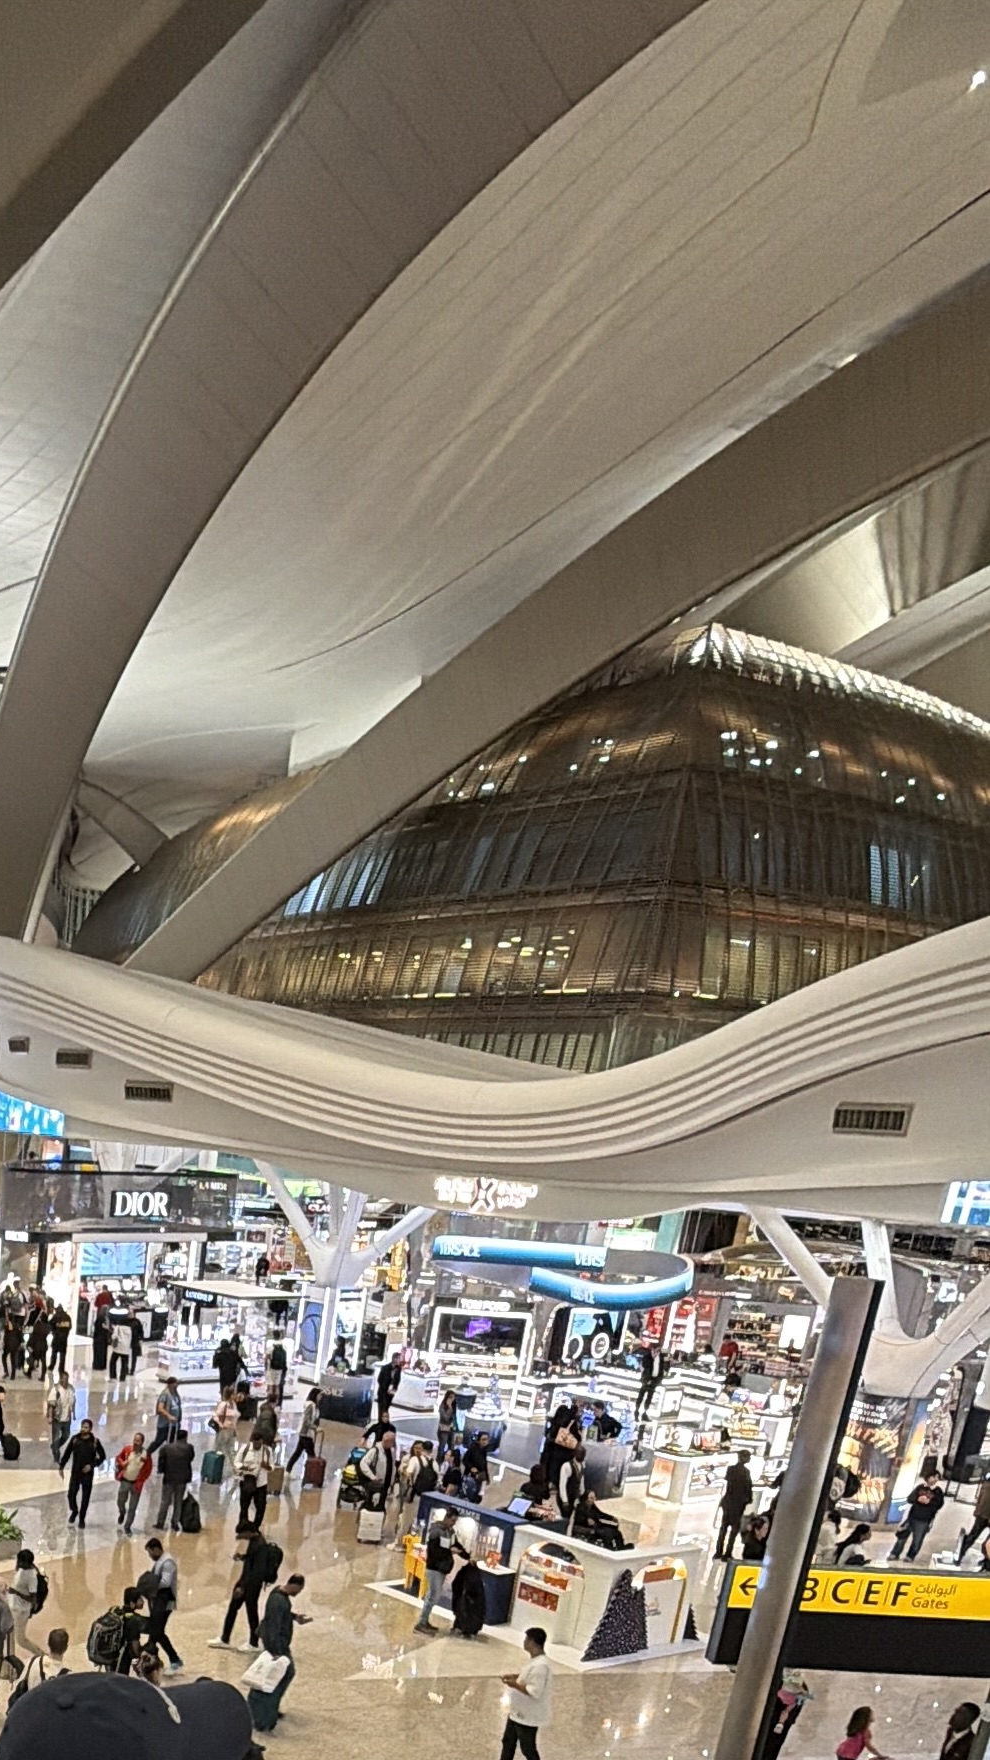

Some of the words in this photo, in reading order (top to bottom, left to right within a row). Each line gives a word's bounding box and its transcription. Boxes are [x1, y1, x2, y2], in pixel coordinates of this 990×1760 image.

[113, 1191, 168, 1217] DIOR
[831, 1578, 856, 1604] C
[862, 1580, 884, 1606] E
[890, 1581, 912, 1607] F
[915, 1584, 958, 1597] البوابات
[911, 1597, 949, 1610] Gates
